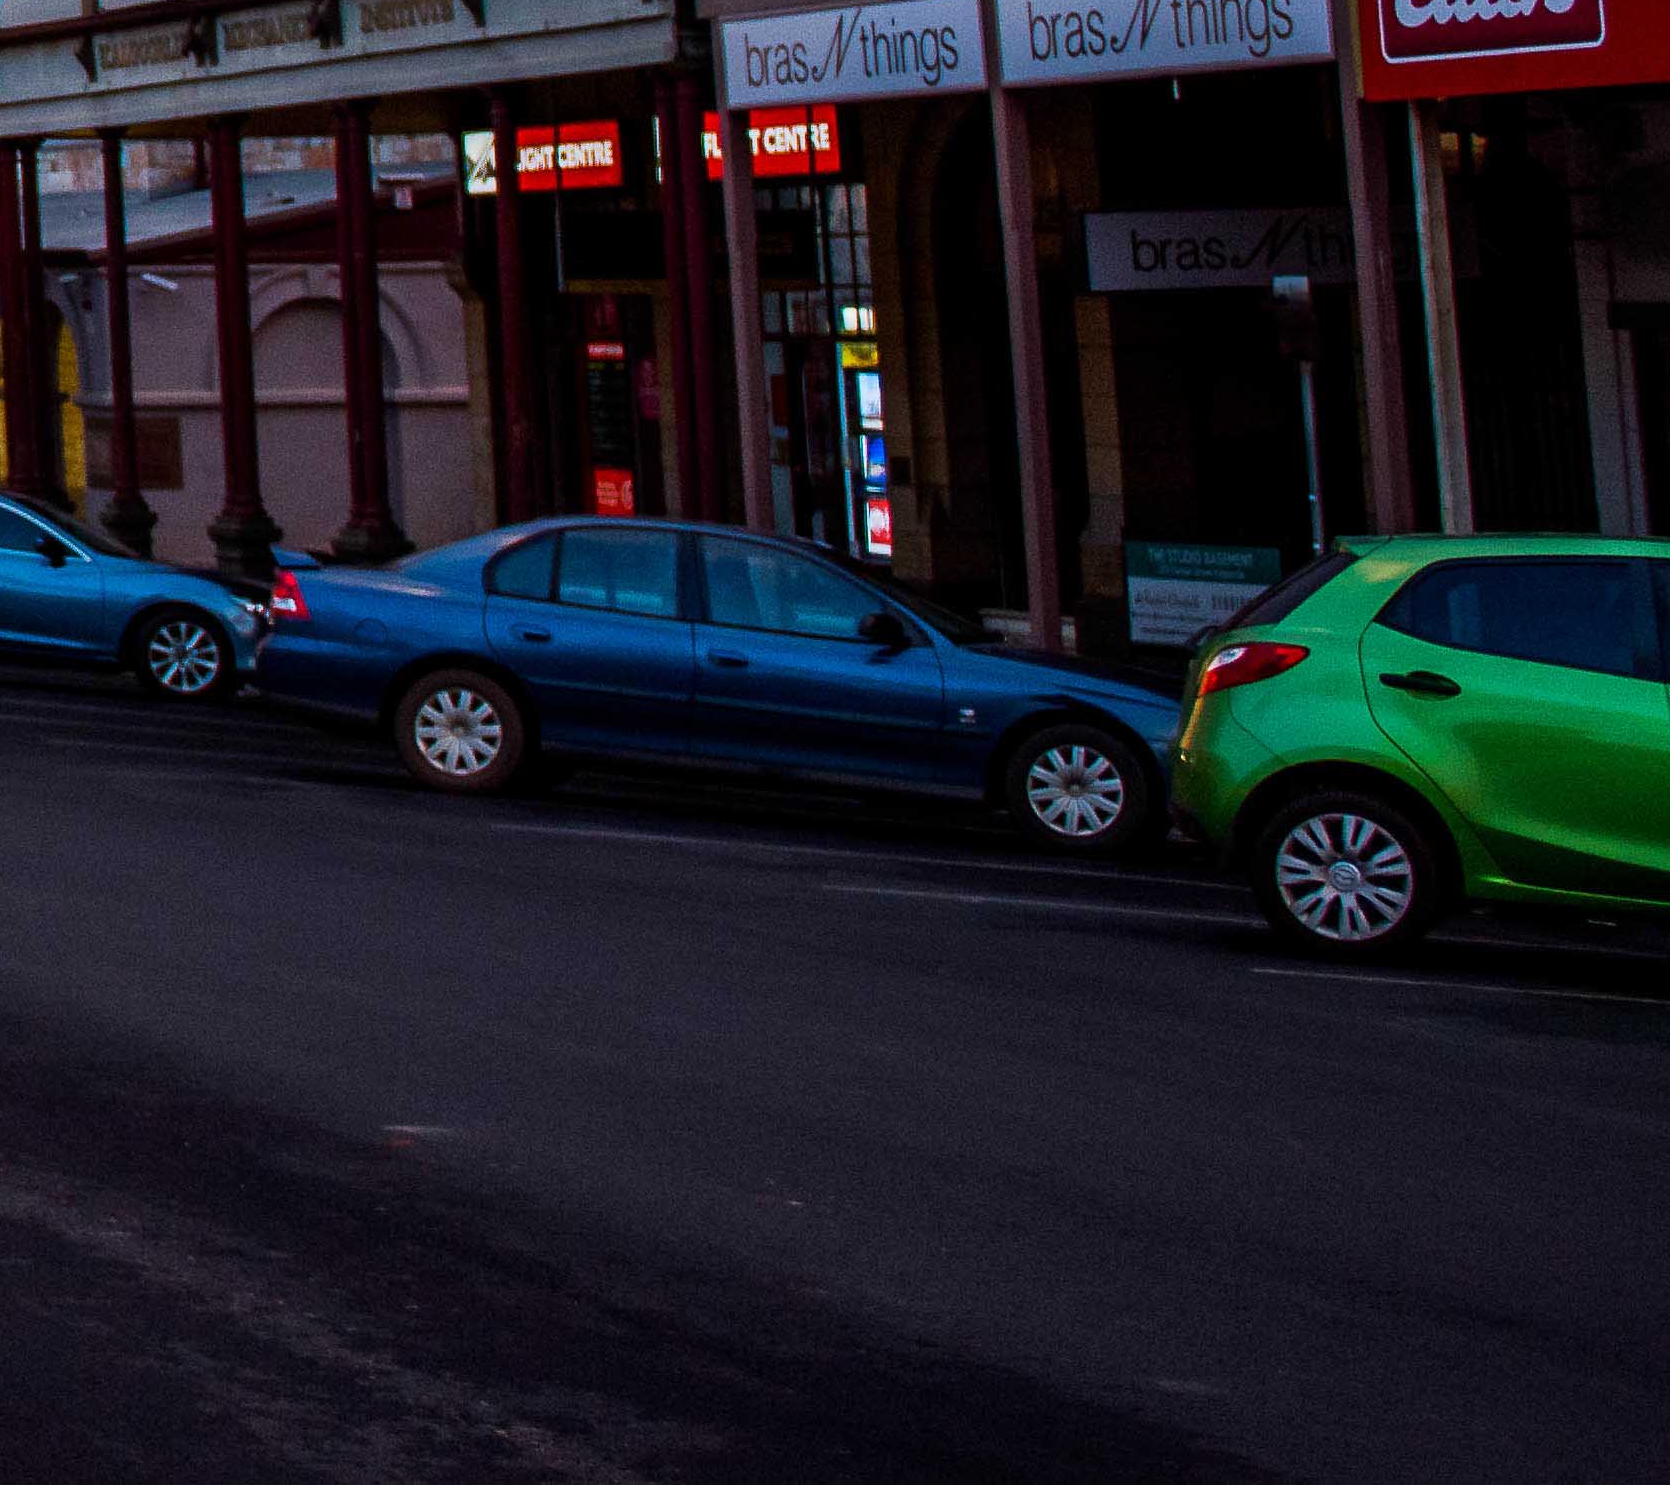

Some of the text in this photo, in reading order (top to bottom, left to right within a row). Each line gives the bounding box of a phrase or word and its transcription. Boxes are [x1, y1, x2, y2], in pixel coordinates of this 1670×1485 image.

[743, 7, 960, 87] bras N things
[1026, 1, 1106, 61] bras
[557, 139, 614, 168] CENTRE
[701, 122, 831, 159] FLT CENTRE
[1131, 228, 1226, 273] bras
